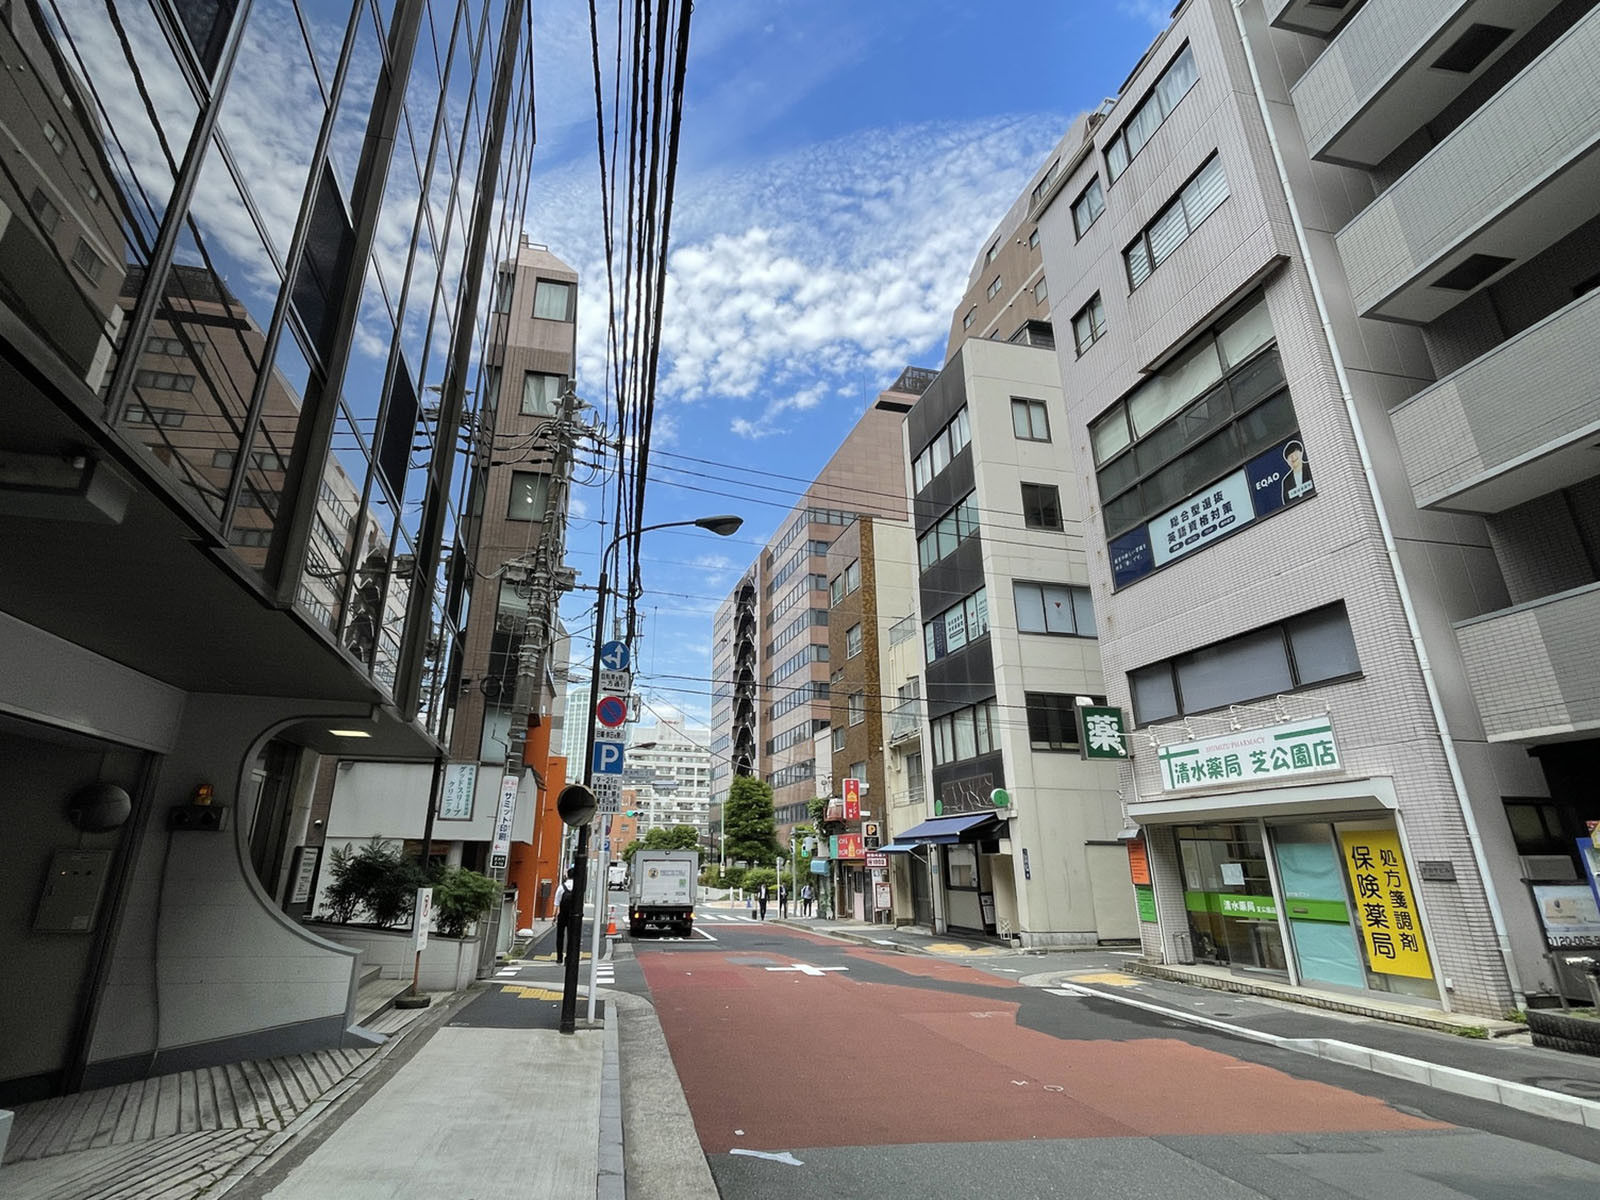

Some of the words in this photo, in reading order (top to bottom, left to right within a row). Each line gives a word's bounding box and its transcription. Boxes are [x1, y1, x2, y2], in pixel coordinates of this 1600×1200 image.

[1256, 472, 1280, 490] EQAO
[1167, 501, 1233, 544] 英語資格対策
[1170, 491, 1224, 528] 総合型選抜
[601, 680, 626, 688] 一方通行
[1086, 714, 1119, 751] 薬
[1231, 737, 1265, 748] PHARMACY
[601, 744, 619, 771] P
[1174, 754, 1242, 784] 清水薬局
[1249, 740, 1337, 774] 芝公園店
[445, 781, 455, 815] クリニック
[454, 766, 467, 816] グッドスリープ
[1223, 900, 1255, 912] 清水薬局
[1351, 846, 1396, 960] 保険薬局
[1380, 849, 1419, 953] 処方箋調剤
